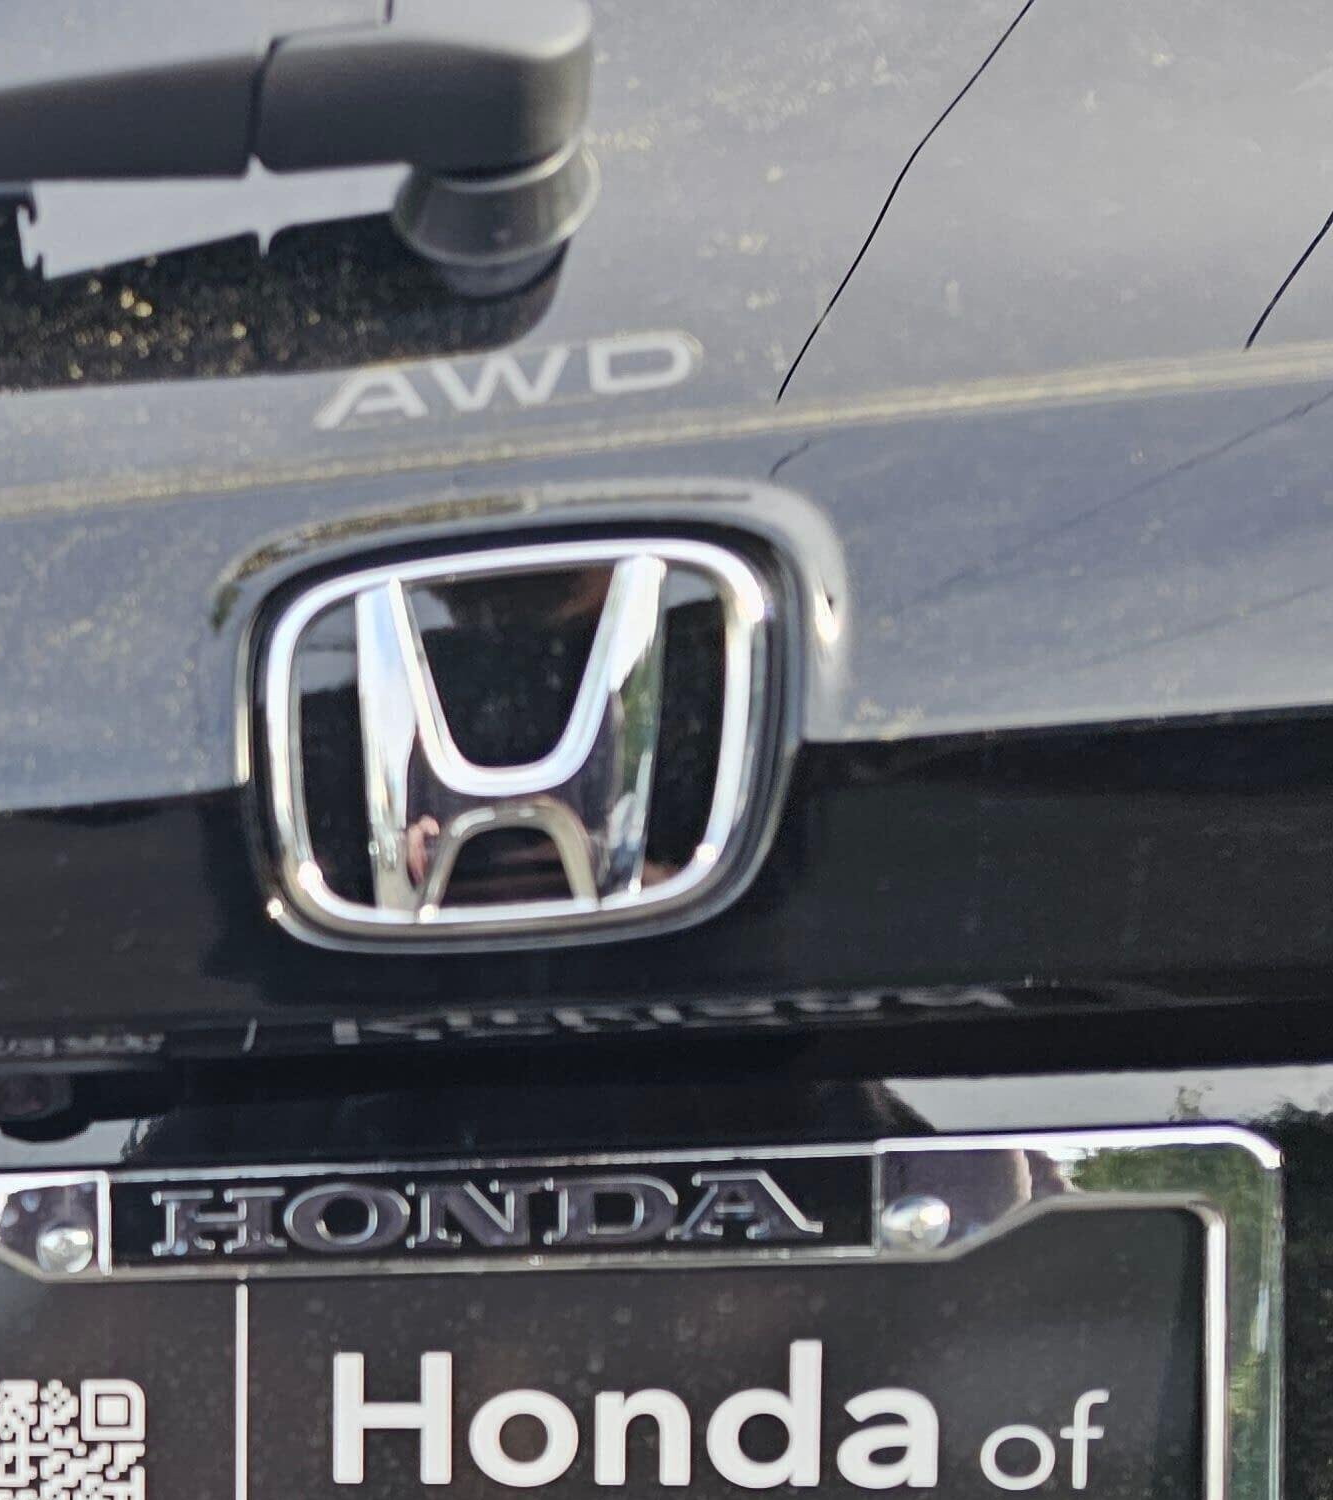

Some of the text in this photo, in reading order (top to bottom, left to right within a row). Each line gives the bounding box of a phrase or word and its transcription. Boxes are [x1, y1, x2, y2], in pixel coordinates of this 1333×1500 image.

[314, 331, 704, 430] AWD
[151, 1170, 825, 1256] HONDA
[332, 1338, 1111, 1491] Honda of
